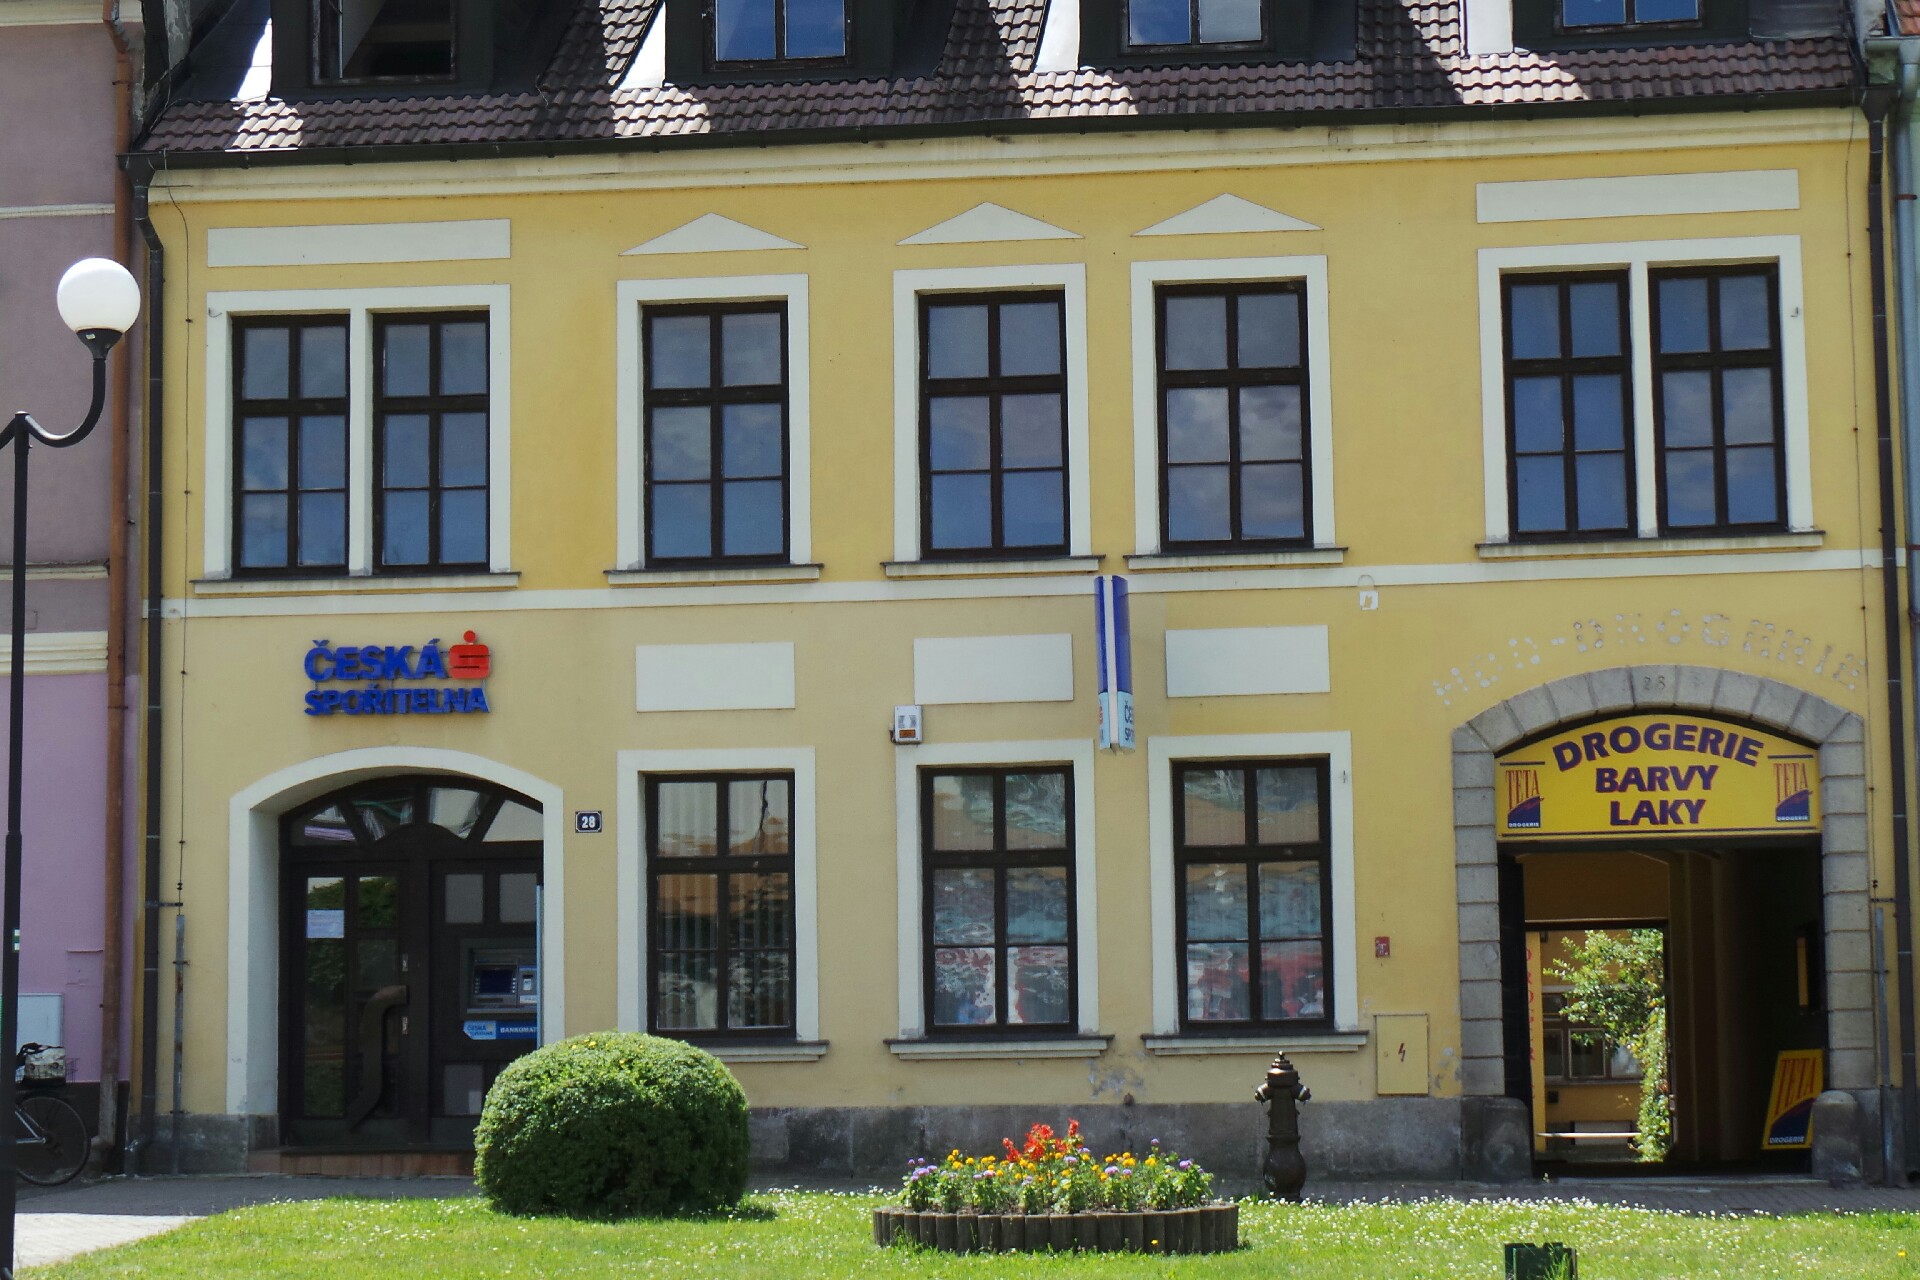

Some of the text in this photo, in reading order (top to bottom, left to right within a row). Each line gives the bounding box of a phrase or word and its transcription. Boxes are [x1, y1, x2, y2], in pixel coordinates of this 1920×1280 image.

[304, 638, 449, 682] ČESKÁ
[1643, 675, 1666, 691] 28
[304, 683, 491, 716] SPOŘITELNA
[1552, 722, 1765, 772] DROGERIE
[1505, 769, 1541, 810] TETA
[1595, 765, 1719, 793] BARVY
[1772, 762, 1809, 804] TETA
[581, 815, 596, 829] 28
[1508, 821, 1541, 829] DROGERIE
[1610, 799, 1706, 826] LAKY
[500, 1026, 538, 1034] BANKOMAT
[1775, 1057, 1817, 1117] TETA
[1769, 1135, 1805, 1144] DROGERIE
